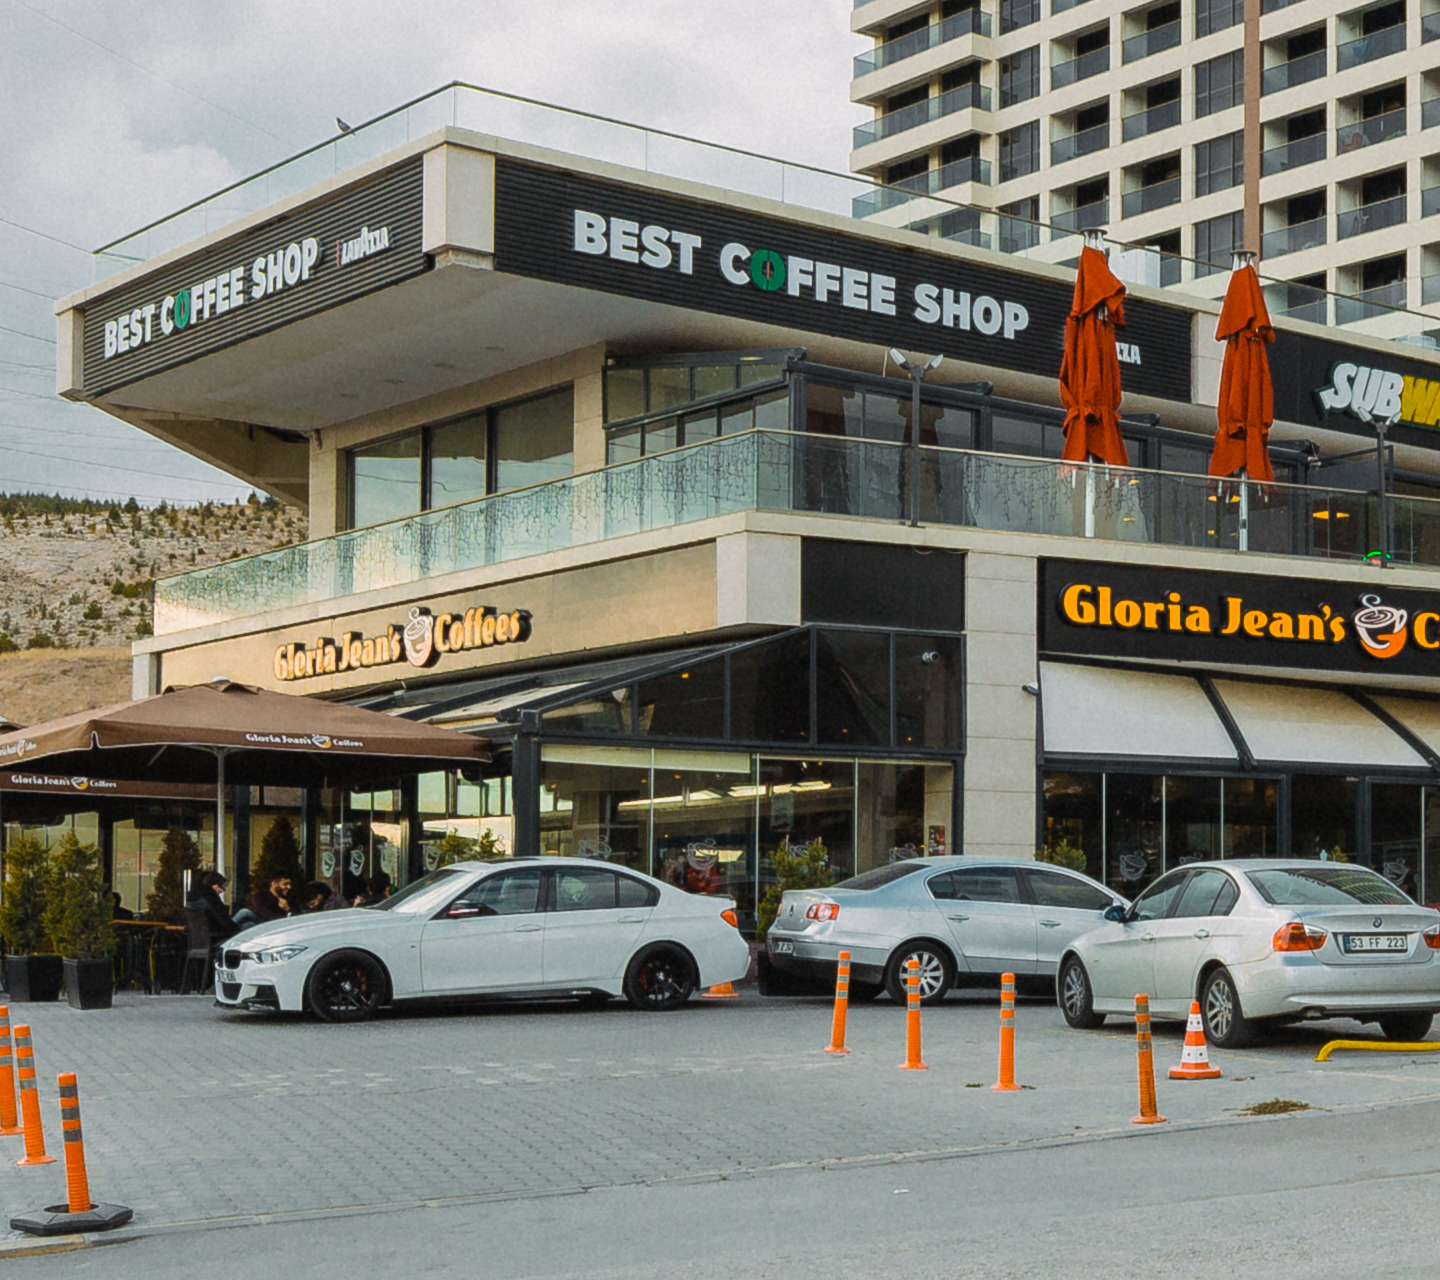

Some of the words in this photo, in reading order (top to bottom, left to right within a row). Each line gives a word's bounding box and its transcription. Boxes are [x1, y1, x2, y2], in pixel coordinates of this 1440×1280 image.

[340, 226, 389, 266] LAVAZZA
[573, 209, 702, 275] BEST
[720, 242, 897, 316] COFFEE
[913, 282, 1030, 339] SHOP
[104, 303, 156, 359] BEST
[160, 265, 245, 336] COFFEE
[251, 237, 319, 299] SHOP
[1063, 583, 1211, 632] Gloria
[1221, 596, 1346, 643] Jean's
[274, 636, 336, 681] Gloria
[339, 623, 402, 672] Jean's
[434, 606, 522, 653] Coffees
[11, 774, 43, 785] Gloria
[1350, 937, 1364, 948] 53
[1369, 938, 1381, 948] FF
[1386, 937, 1405, 948] 223
